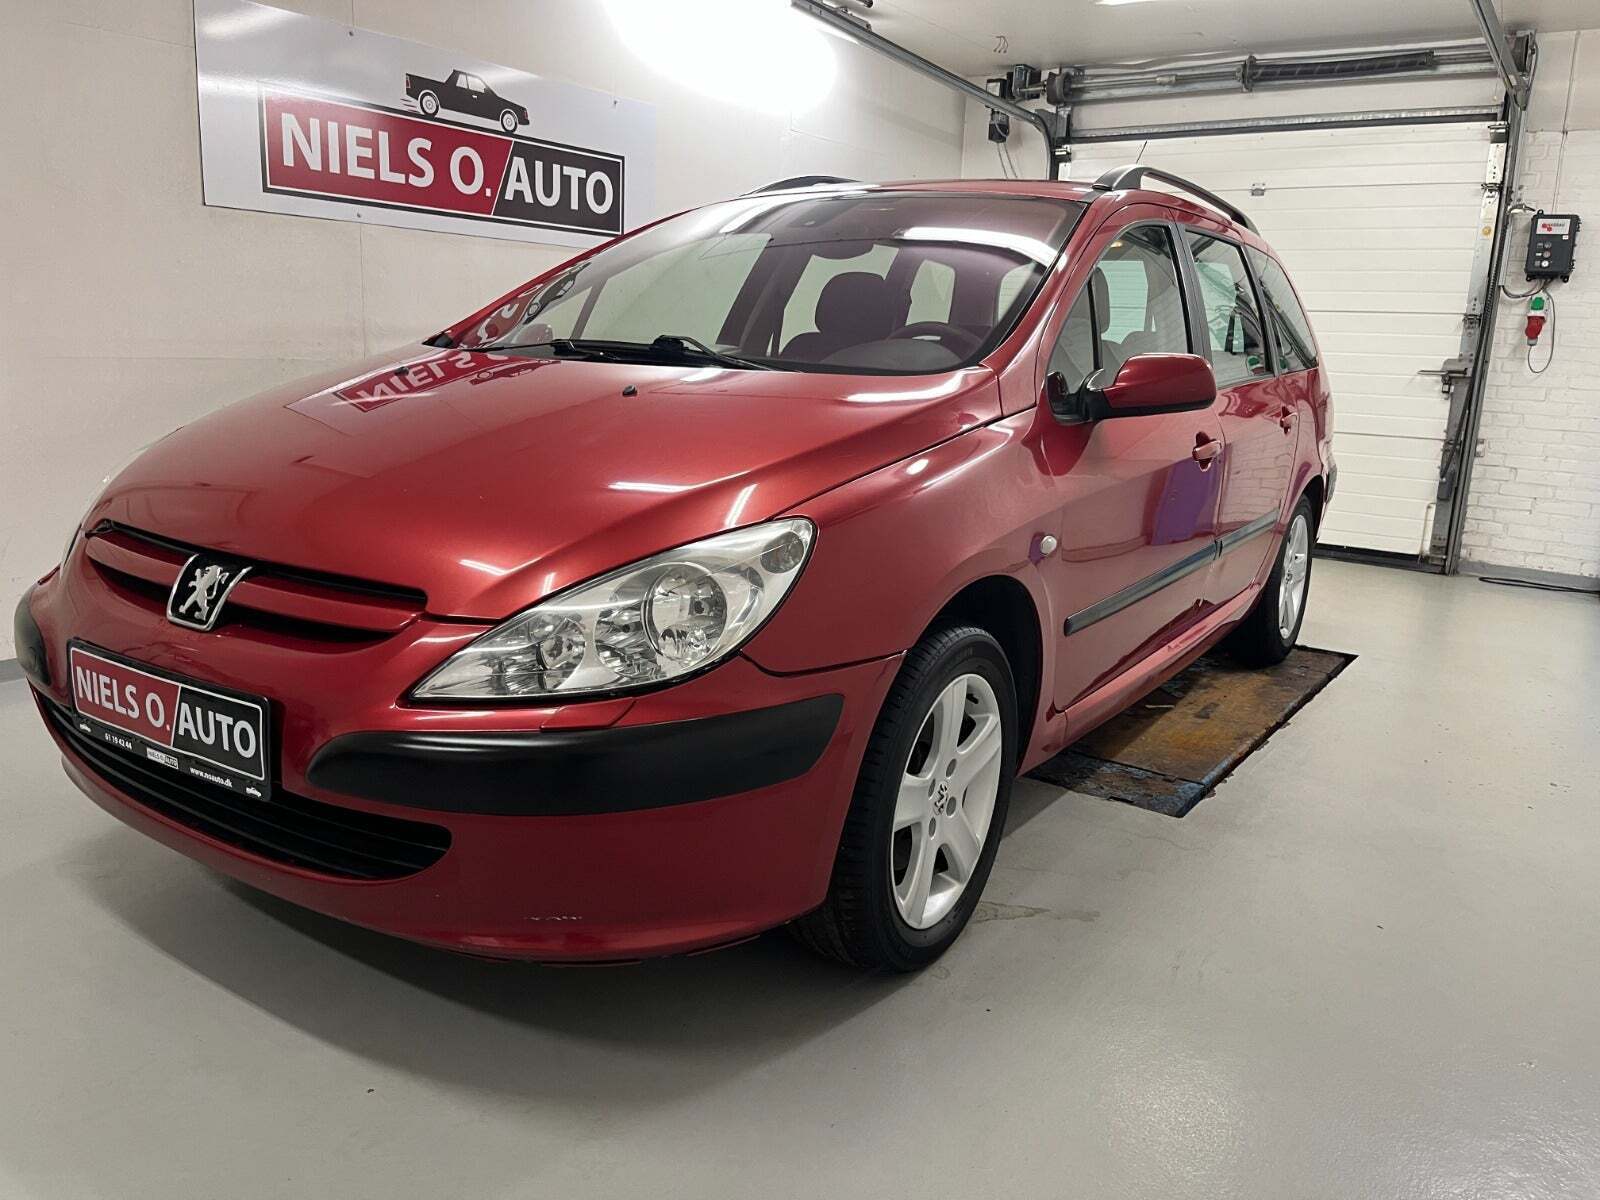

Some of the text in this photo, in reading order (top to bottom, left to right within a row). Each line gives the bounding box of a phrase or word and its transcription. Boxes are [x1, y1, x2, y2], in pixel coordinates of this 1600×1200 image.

[280, 112, 614, 215] NIELS O. AUTO
[75, 665, 257, 759] NIELS O. AUTO
